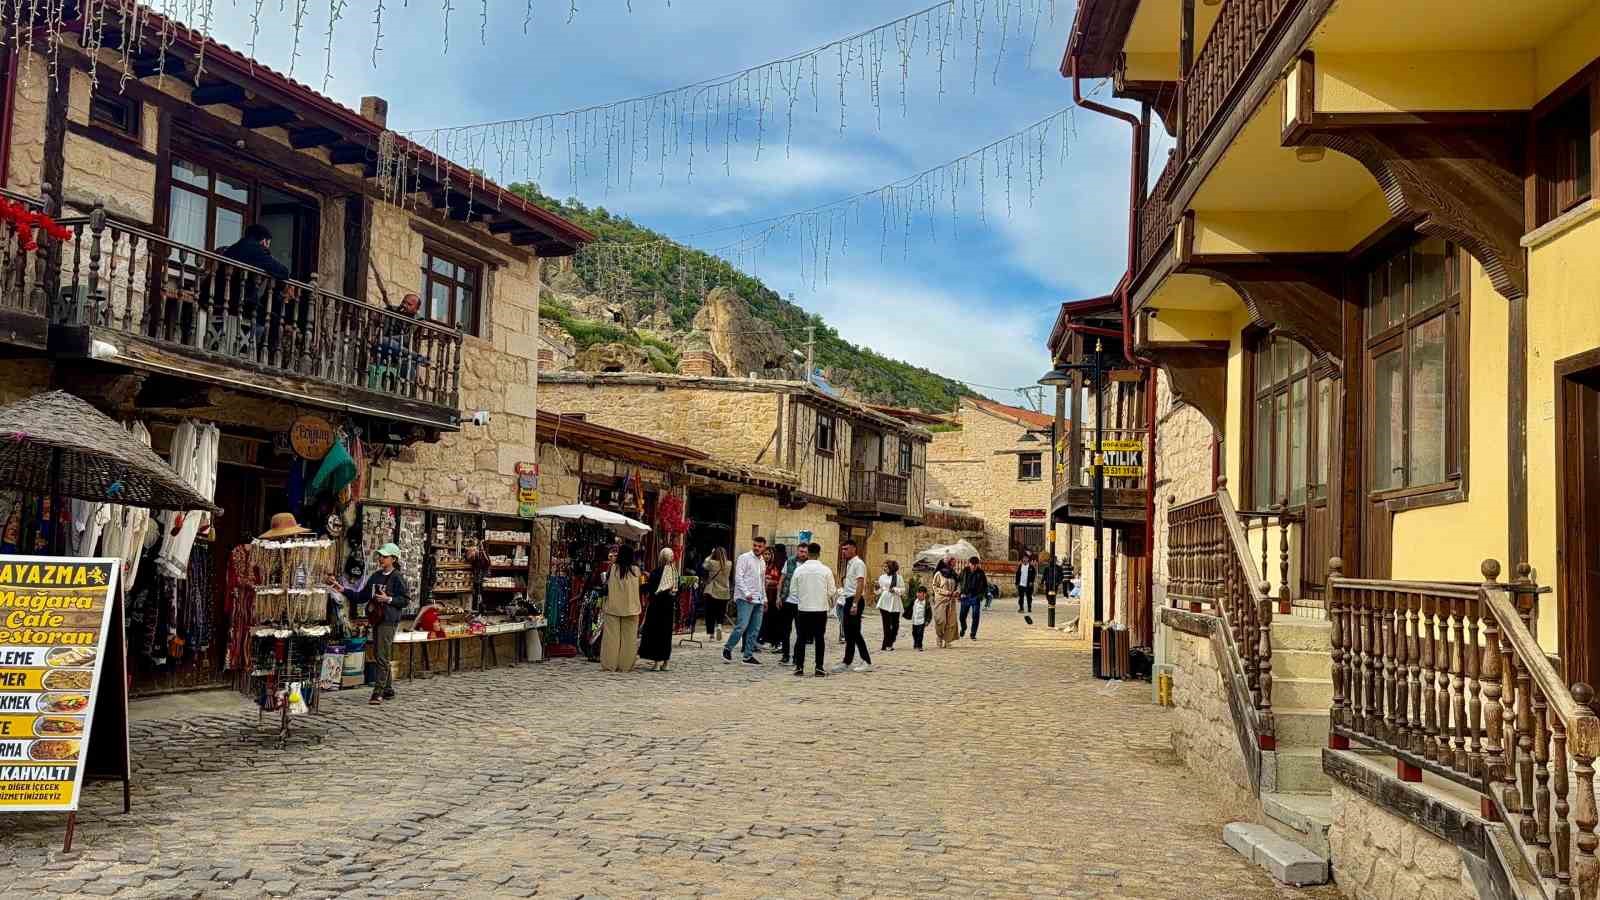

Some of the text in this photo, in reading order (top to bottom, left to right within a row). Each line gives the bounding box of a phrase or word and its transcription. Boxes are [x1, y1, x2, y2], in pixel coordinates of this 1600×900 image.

[1103, 451, 1138, 466] ATILIK
[0, 564, 87, 585] AYAZMA
[0, 590, 93, 612] Mağara
[6, 610, 64, 629] Cafe
[0, 629, 94, 644] estoran
[0, 695, 31, 710] KMEK
[0, 720, 12, 735] E
[0, 766, 70, 781] KAHVALTI
